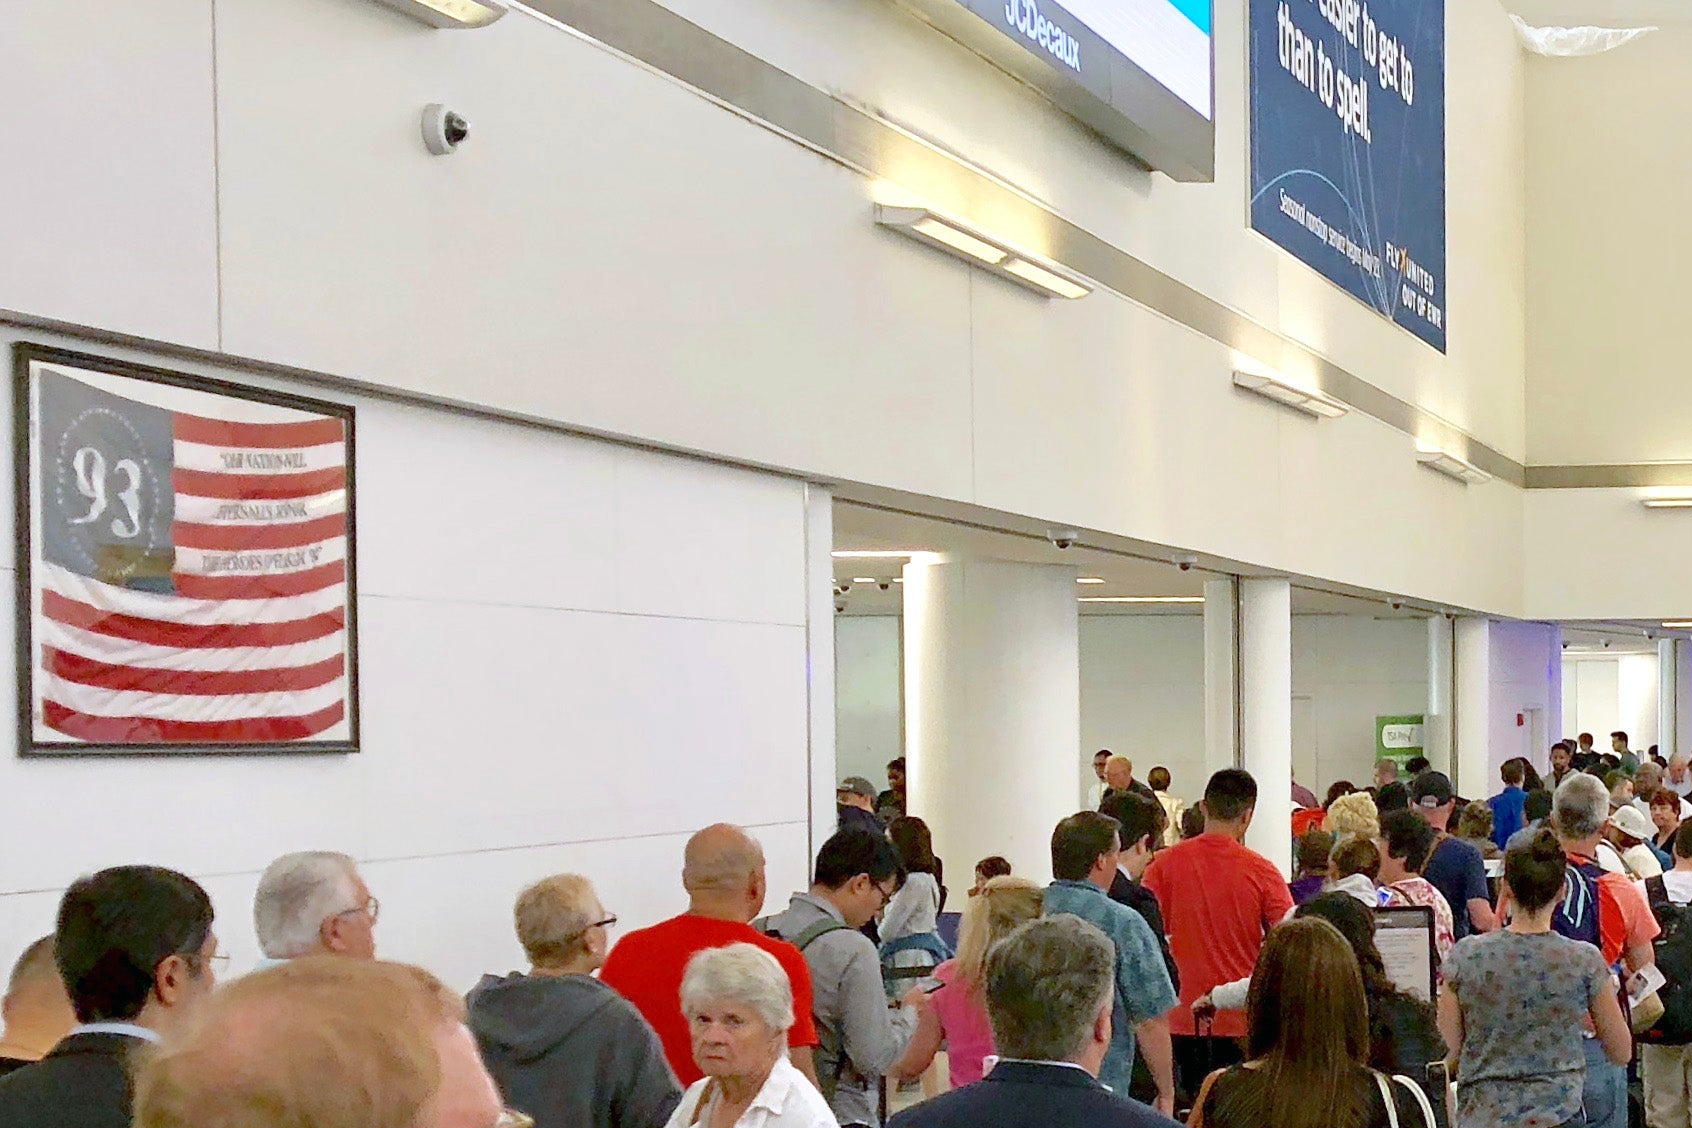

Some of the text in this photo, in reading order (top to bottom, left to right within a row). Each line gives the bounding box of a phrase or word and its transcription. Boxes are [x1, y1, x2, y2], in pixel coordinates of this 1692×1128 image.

[1005, 0, 1081, 72] JCDecaux
[1278, 1, 1371, 144] than to spell.
[1362, 1, 1377, 67] to
[1379, 31, 1398, 92] get
[1401, 45, 1414, 105] to
[1386, 241, 1433, 296] FLY UNITED
[1402, 284, 1442, 329] OUT OF EWR
[68, 447, 141, 538] 93
